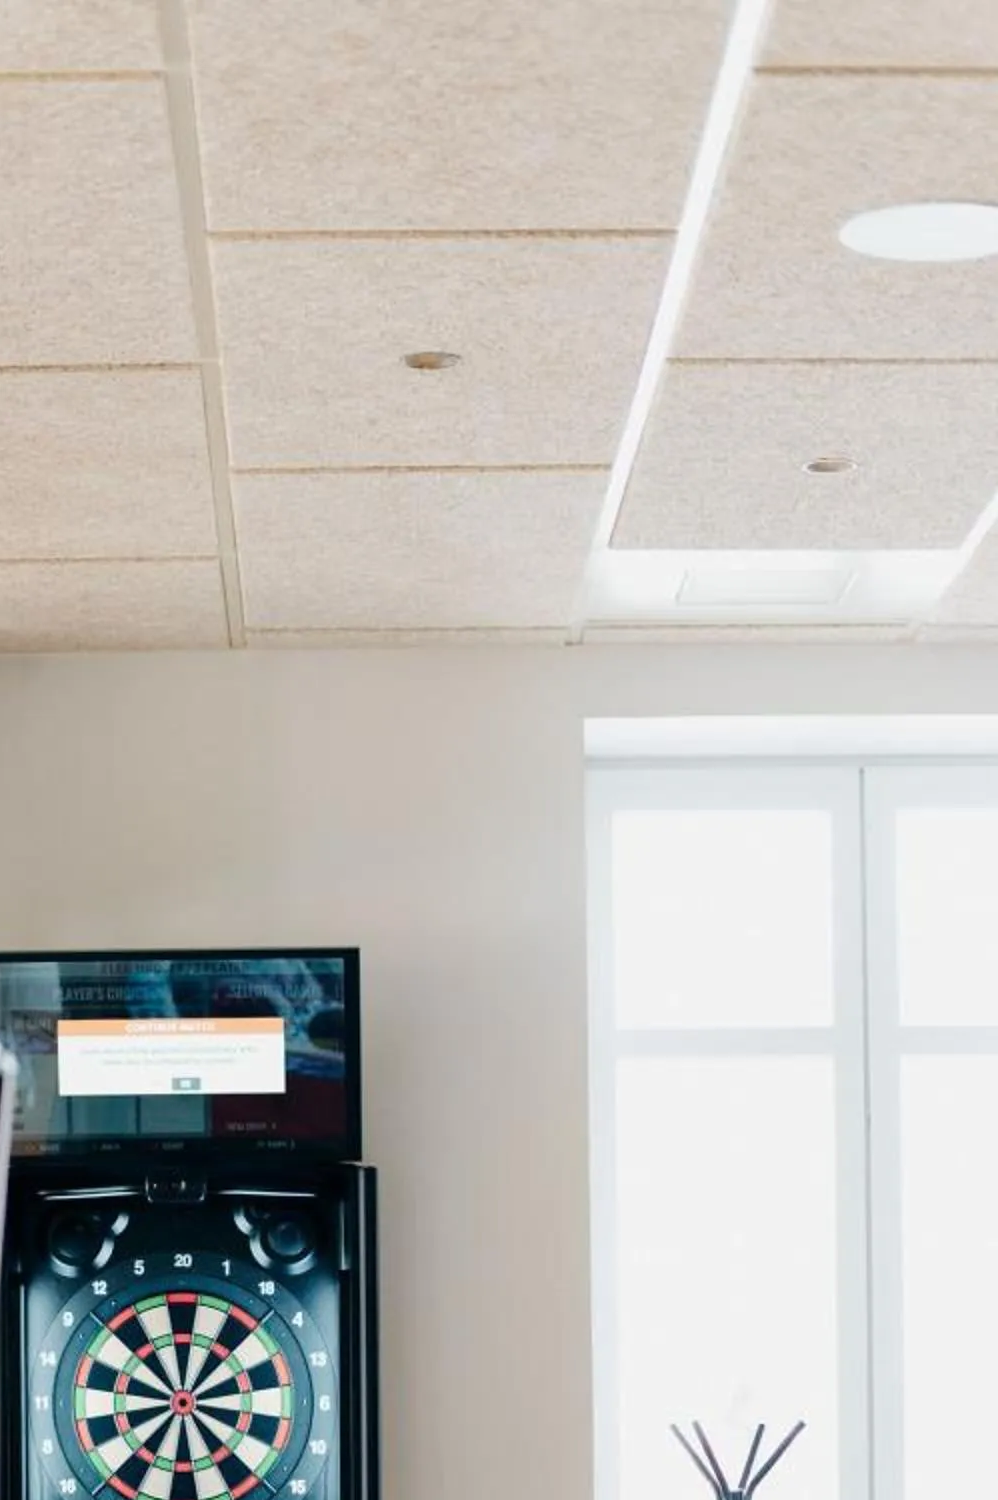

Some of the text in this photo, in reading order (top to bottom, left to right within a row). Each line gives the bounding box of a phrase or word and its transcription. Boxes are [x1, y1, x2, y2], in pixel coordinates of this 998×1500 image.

[134, 1259, 145, 1275] 5
[174, 1253, 193, 1268] 20
[222, 1260, 230, 1276] 1
[91, 1280, 107, 1295] 12
[258, 1280, 275, 1296] 18
[62, 1311, 74, 1328] 9
[291, 1311, 304, 1328] 4
[39, 1351, 57, 1367] 14
[310, 1351, 328, 1367] 13
[34, 1395, 49, 1410] 11
[319, 1394, 331, 1412] 6
[41, 1439, 53, 1455] 8
[309, 1439, 327, 1455] 10
[59, 1478, 77, 1494] 16
[289, 1479, 307, 1495] 15
